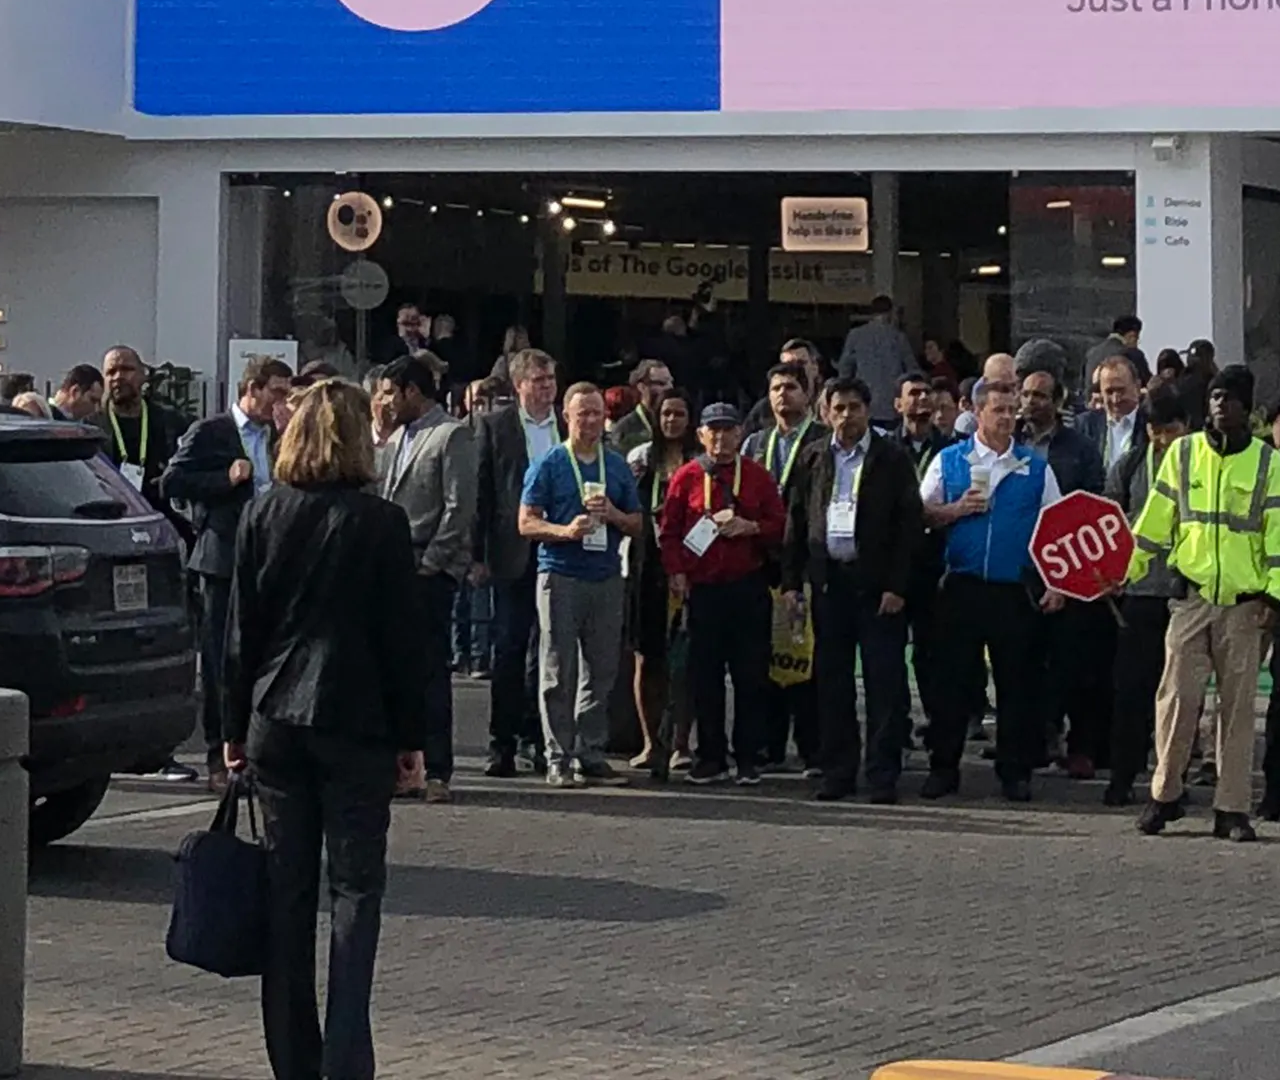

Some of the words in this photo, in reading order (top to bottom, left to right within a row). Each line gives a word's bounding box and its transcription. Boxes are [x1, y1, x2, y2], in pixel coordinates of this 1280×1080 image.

[587, 255, 614, 274] of
[617, 254, 663, 276] The
[666, 256, 748, 284] Google
[1040, 513, 1123, 581] STOP
